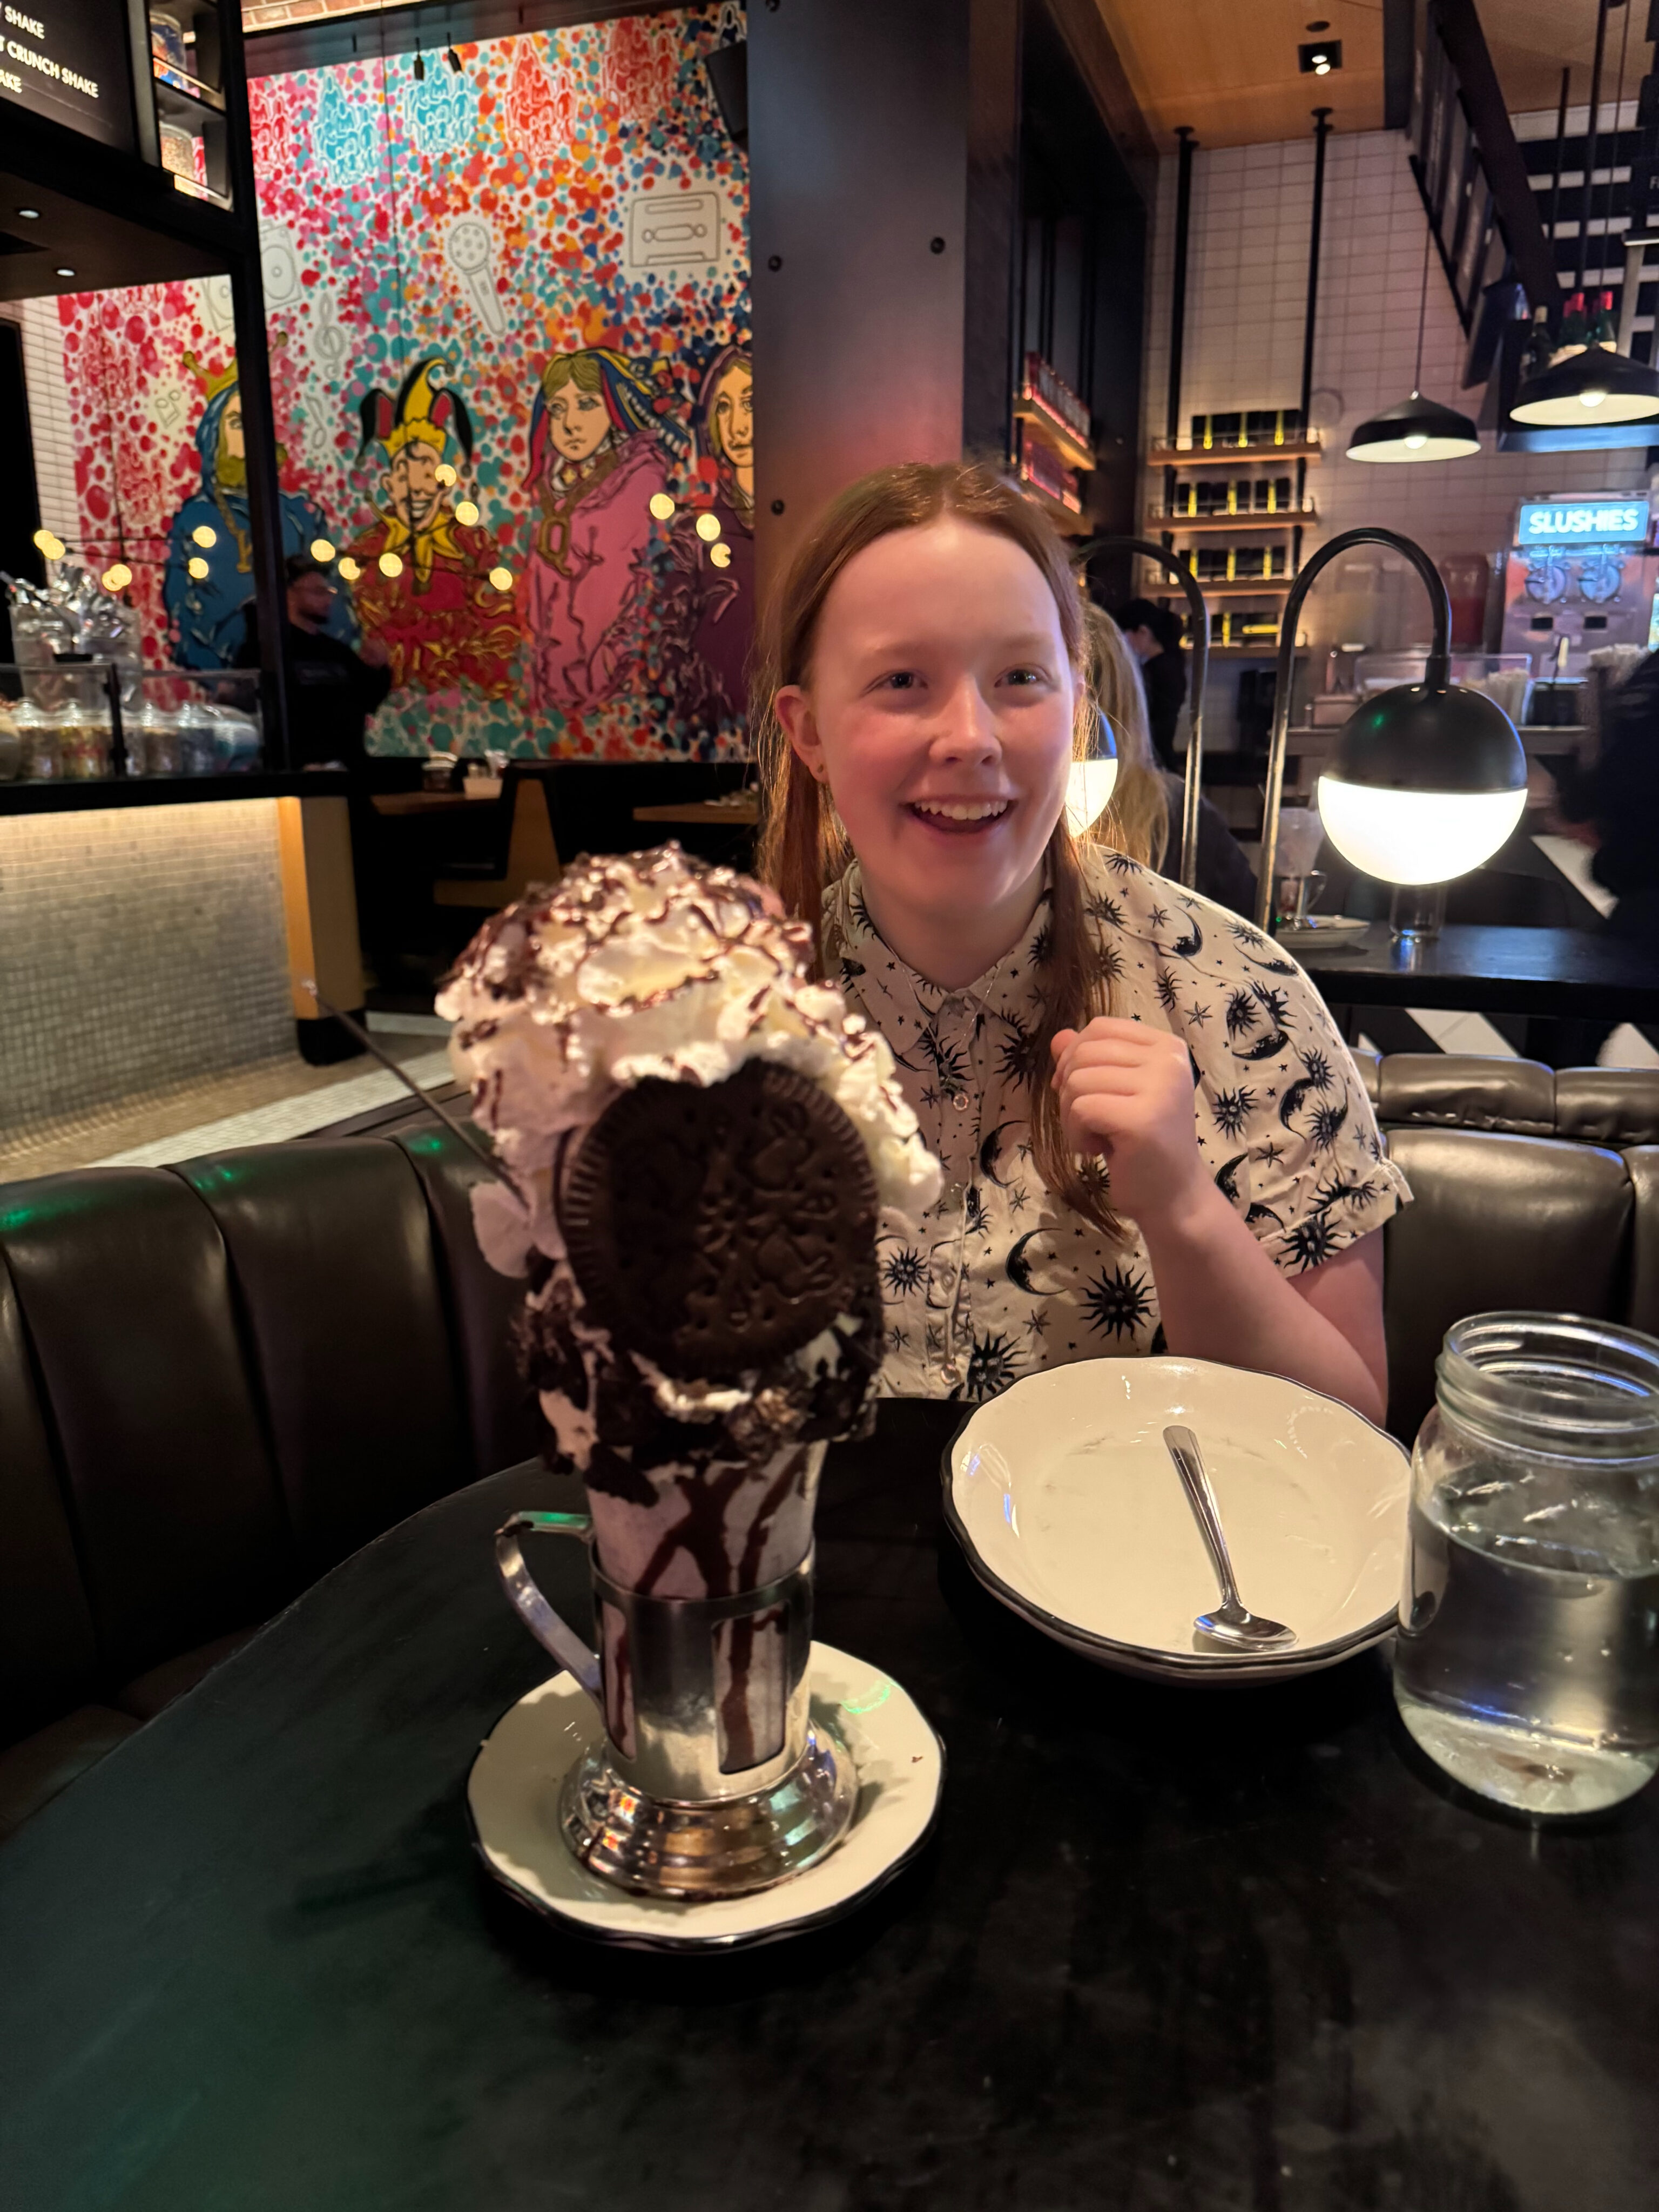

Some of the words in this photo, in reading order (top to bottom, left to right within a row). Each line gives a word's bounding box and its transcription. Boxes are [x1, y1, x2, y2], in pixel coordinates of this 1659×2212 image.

[4, 5, 45, 39] SHAKE
[7, 41, 60, 79] CRUNCH
[61, 68, 99, 98] SHAKE
[1528, 508, 1639, 535] SLUSHIES
